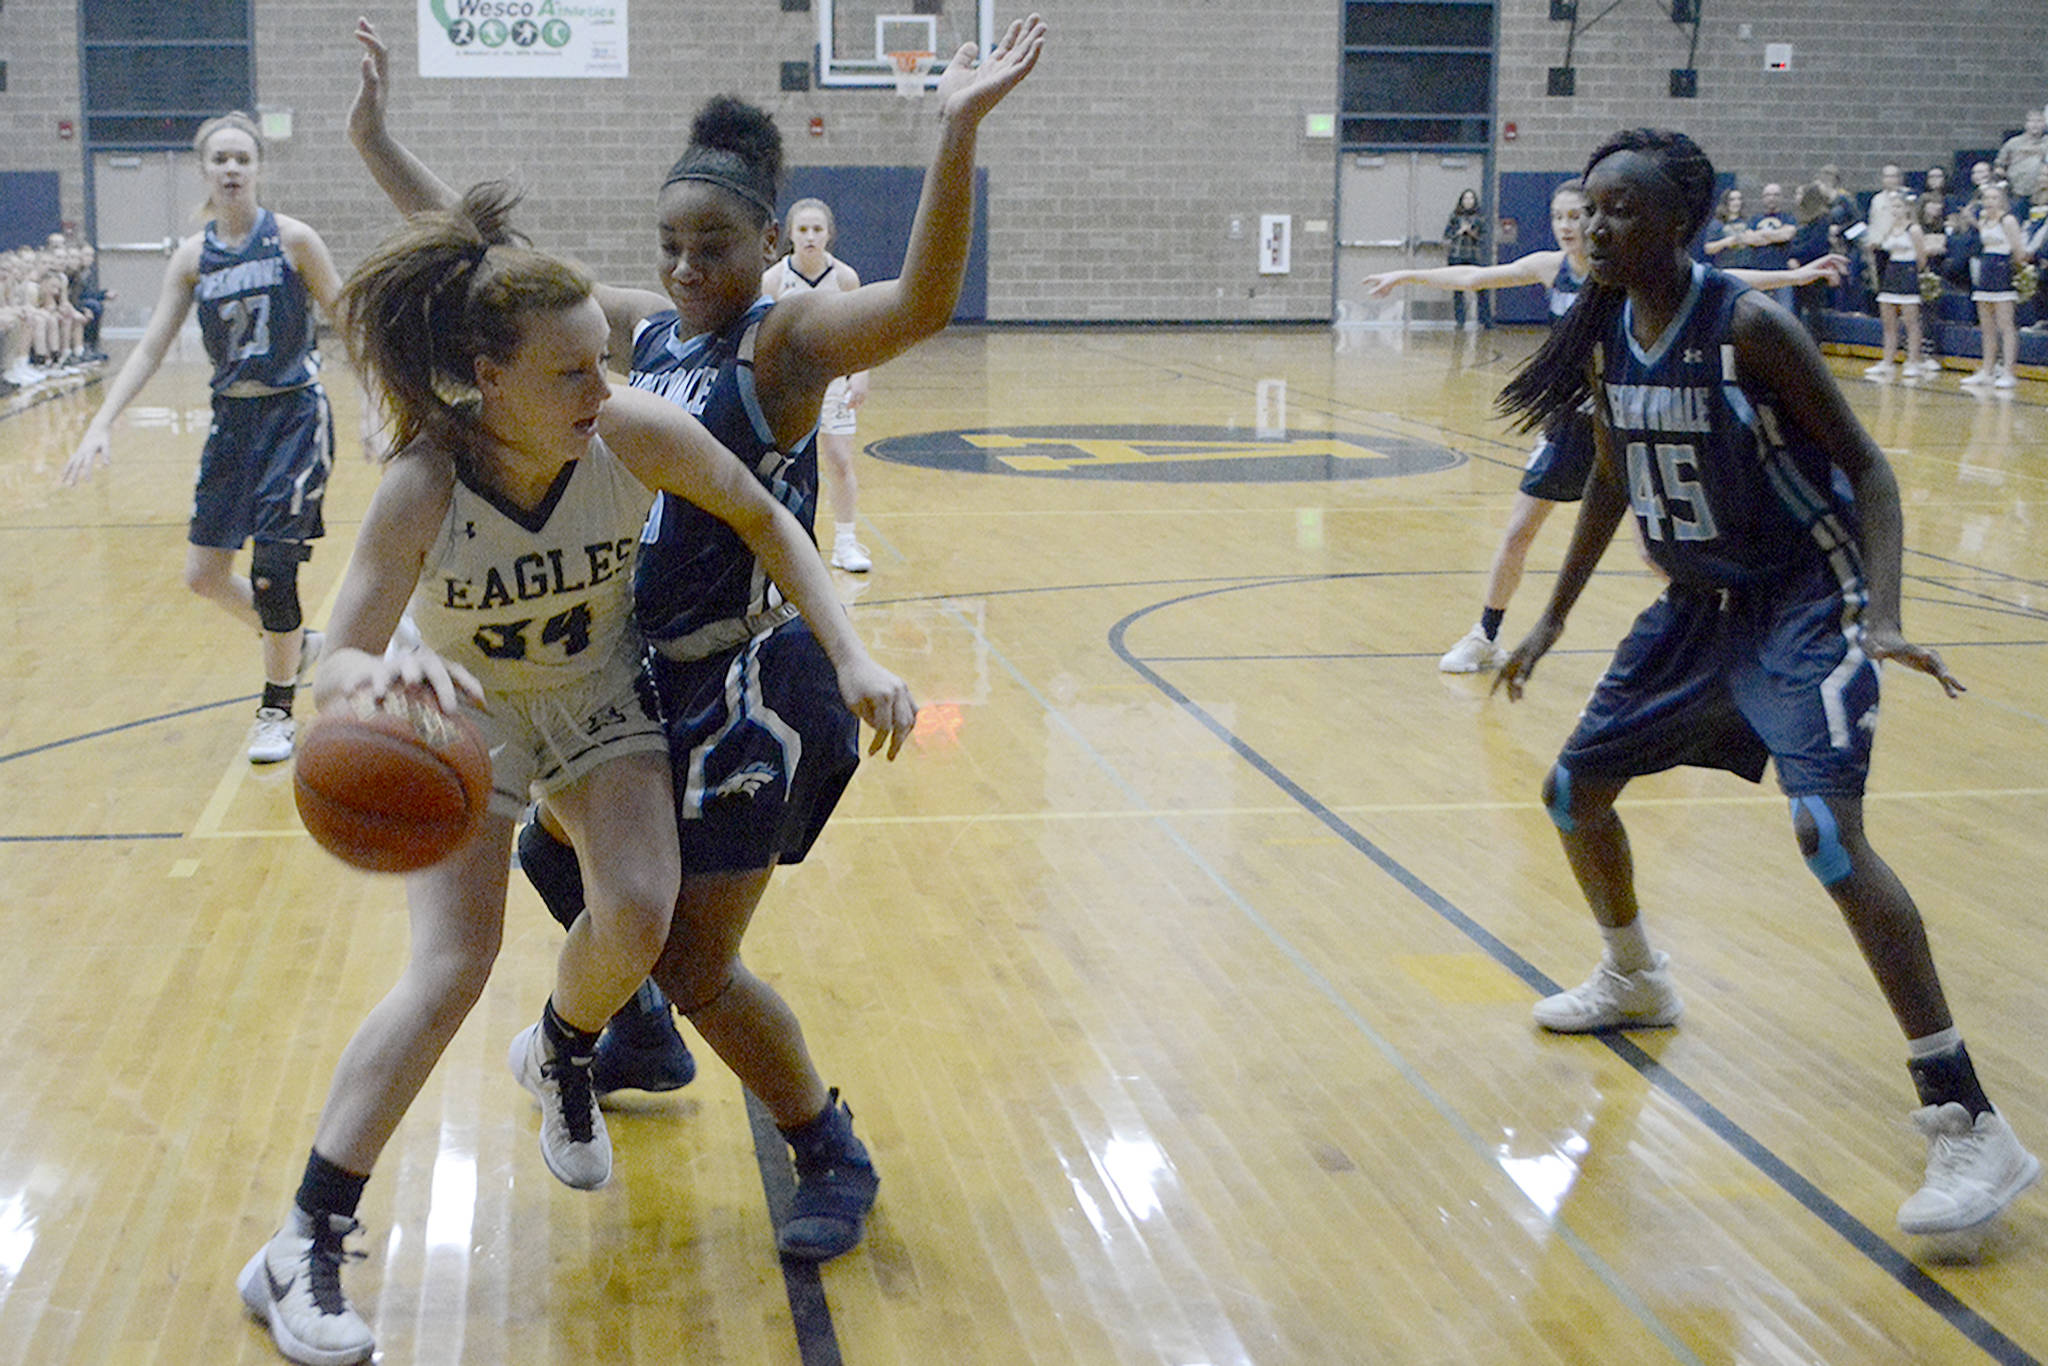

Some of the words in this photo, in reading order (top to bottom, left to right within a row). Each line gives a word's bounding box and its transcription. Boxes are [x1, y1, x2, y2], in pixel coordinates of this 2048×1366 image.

[458, 0, 533, 17] Wesco
[1626, 442, 1719, 541] 45
[444, 538, 632, 610] EAGLES
